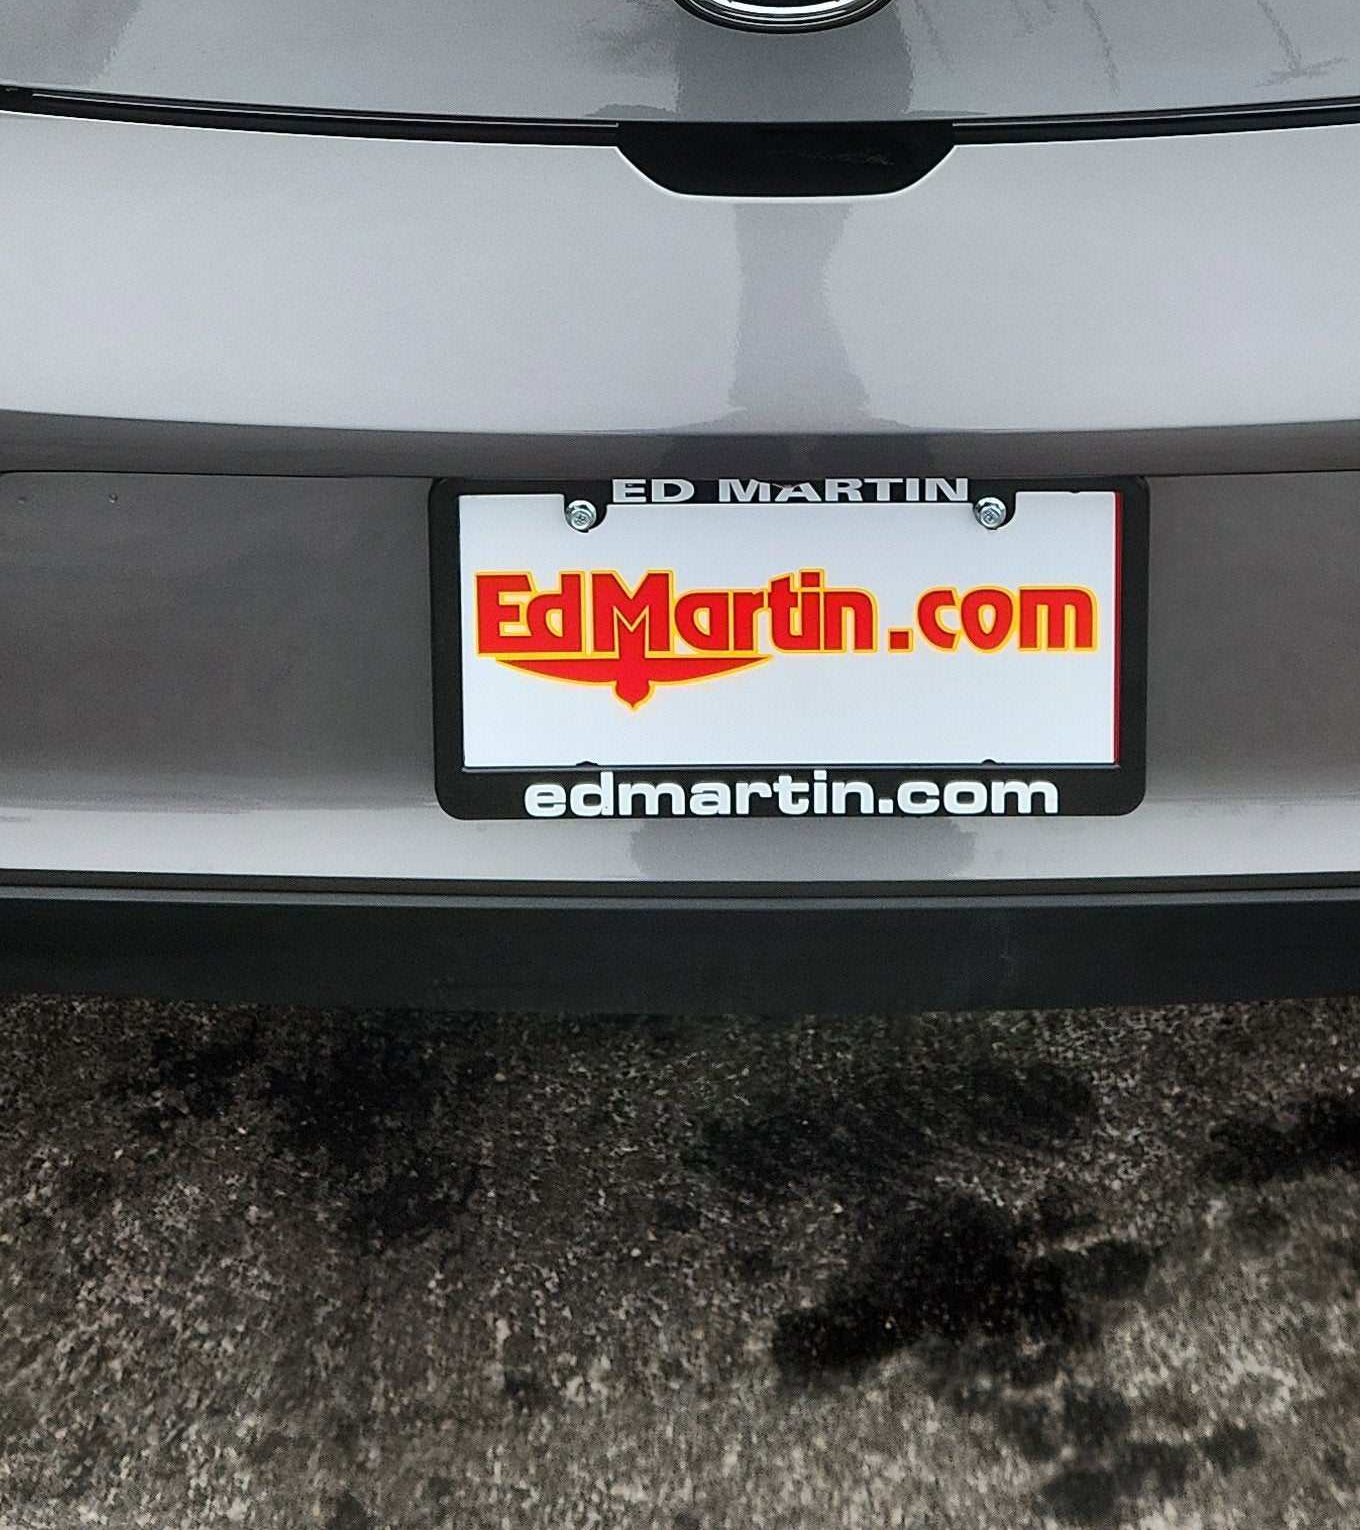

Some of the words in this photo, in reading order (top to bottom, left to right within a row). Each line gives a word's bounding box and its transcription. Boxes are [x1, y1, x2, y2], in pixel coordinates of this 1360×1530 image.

[612, 478, 695, 503] ED
[718, 477, 969, 503] MARTIN
[474, 569, 1099, 657] EdMartin.com
[523, 771, 1059, 818] edmartin.com
